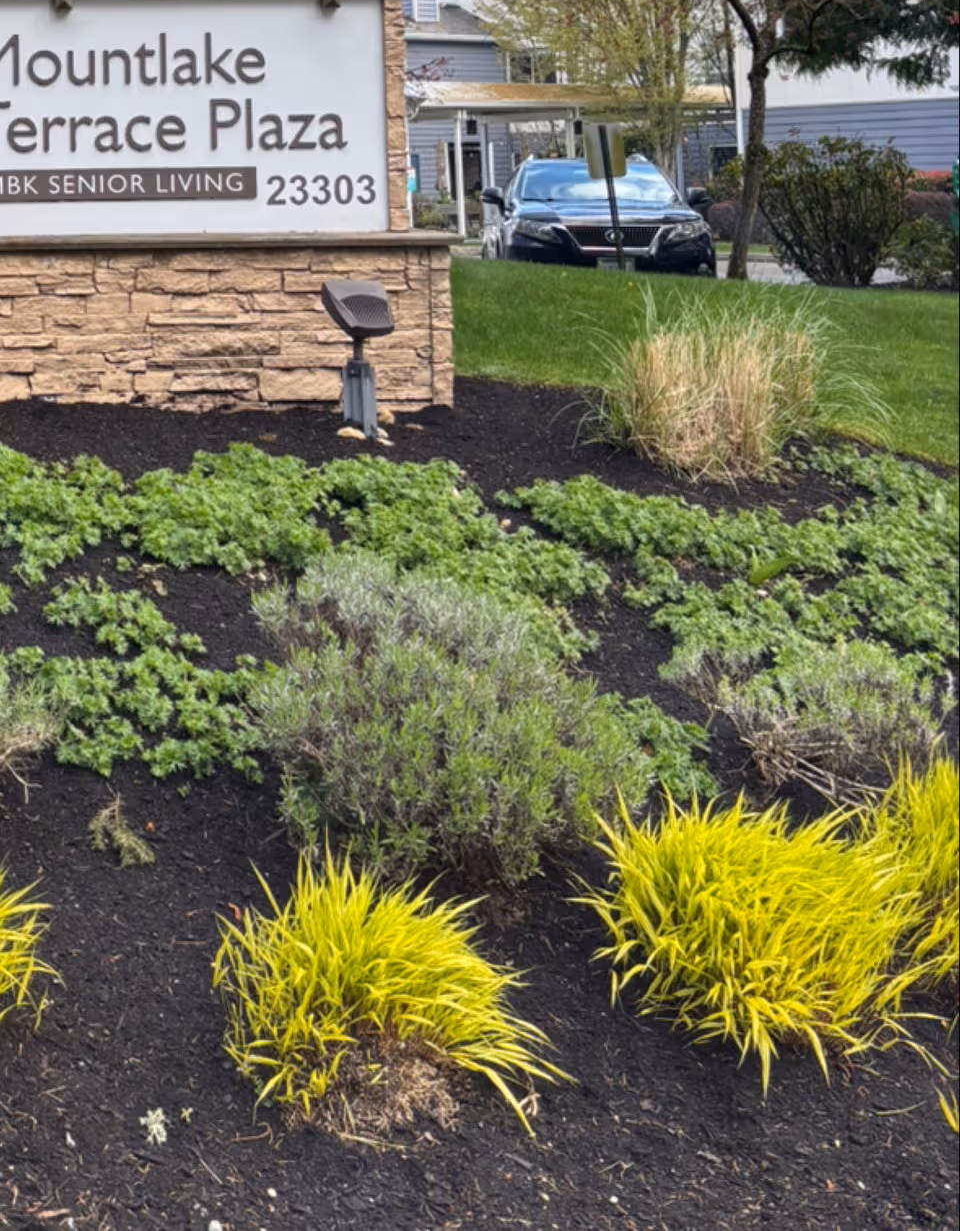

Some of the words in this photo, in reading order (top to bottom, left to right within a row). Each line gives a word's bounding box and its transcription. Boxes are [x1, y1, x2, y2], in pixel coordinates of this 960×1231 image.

[209, 98, 348, 151] Plaza
[48, 174, 146, 195] SENIOR
[156, 172, 244, 193] LIVING
[267, 174, 376, 206] 23303
